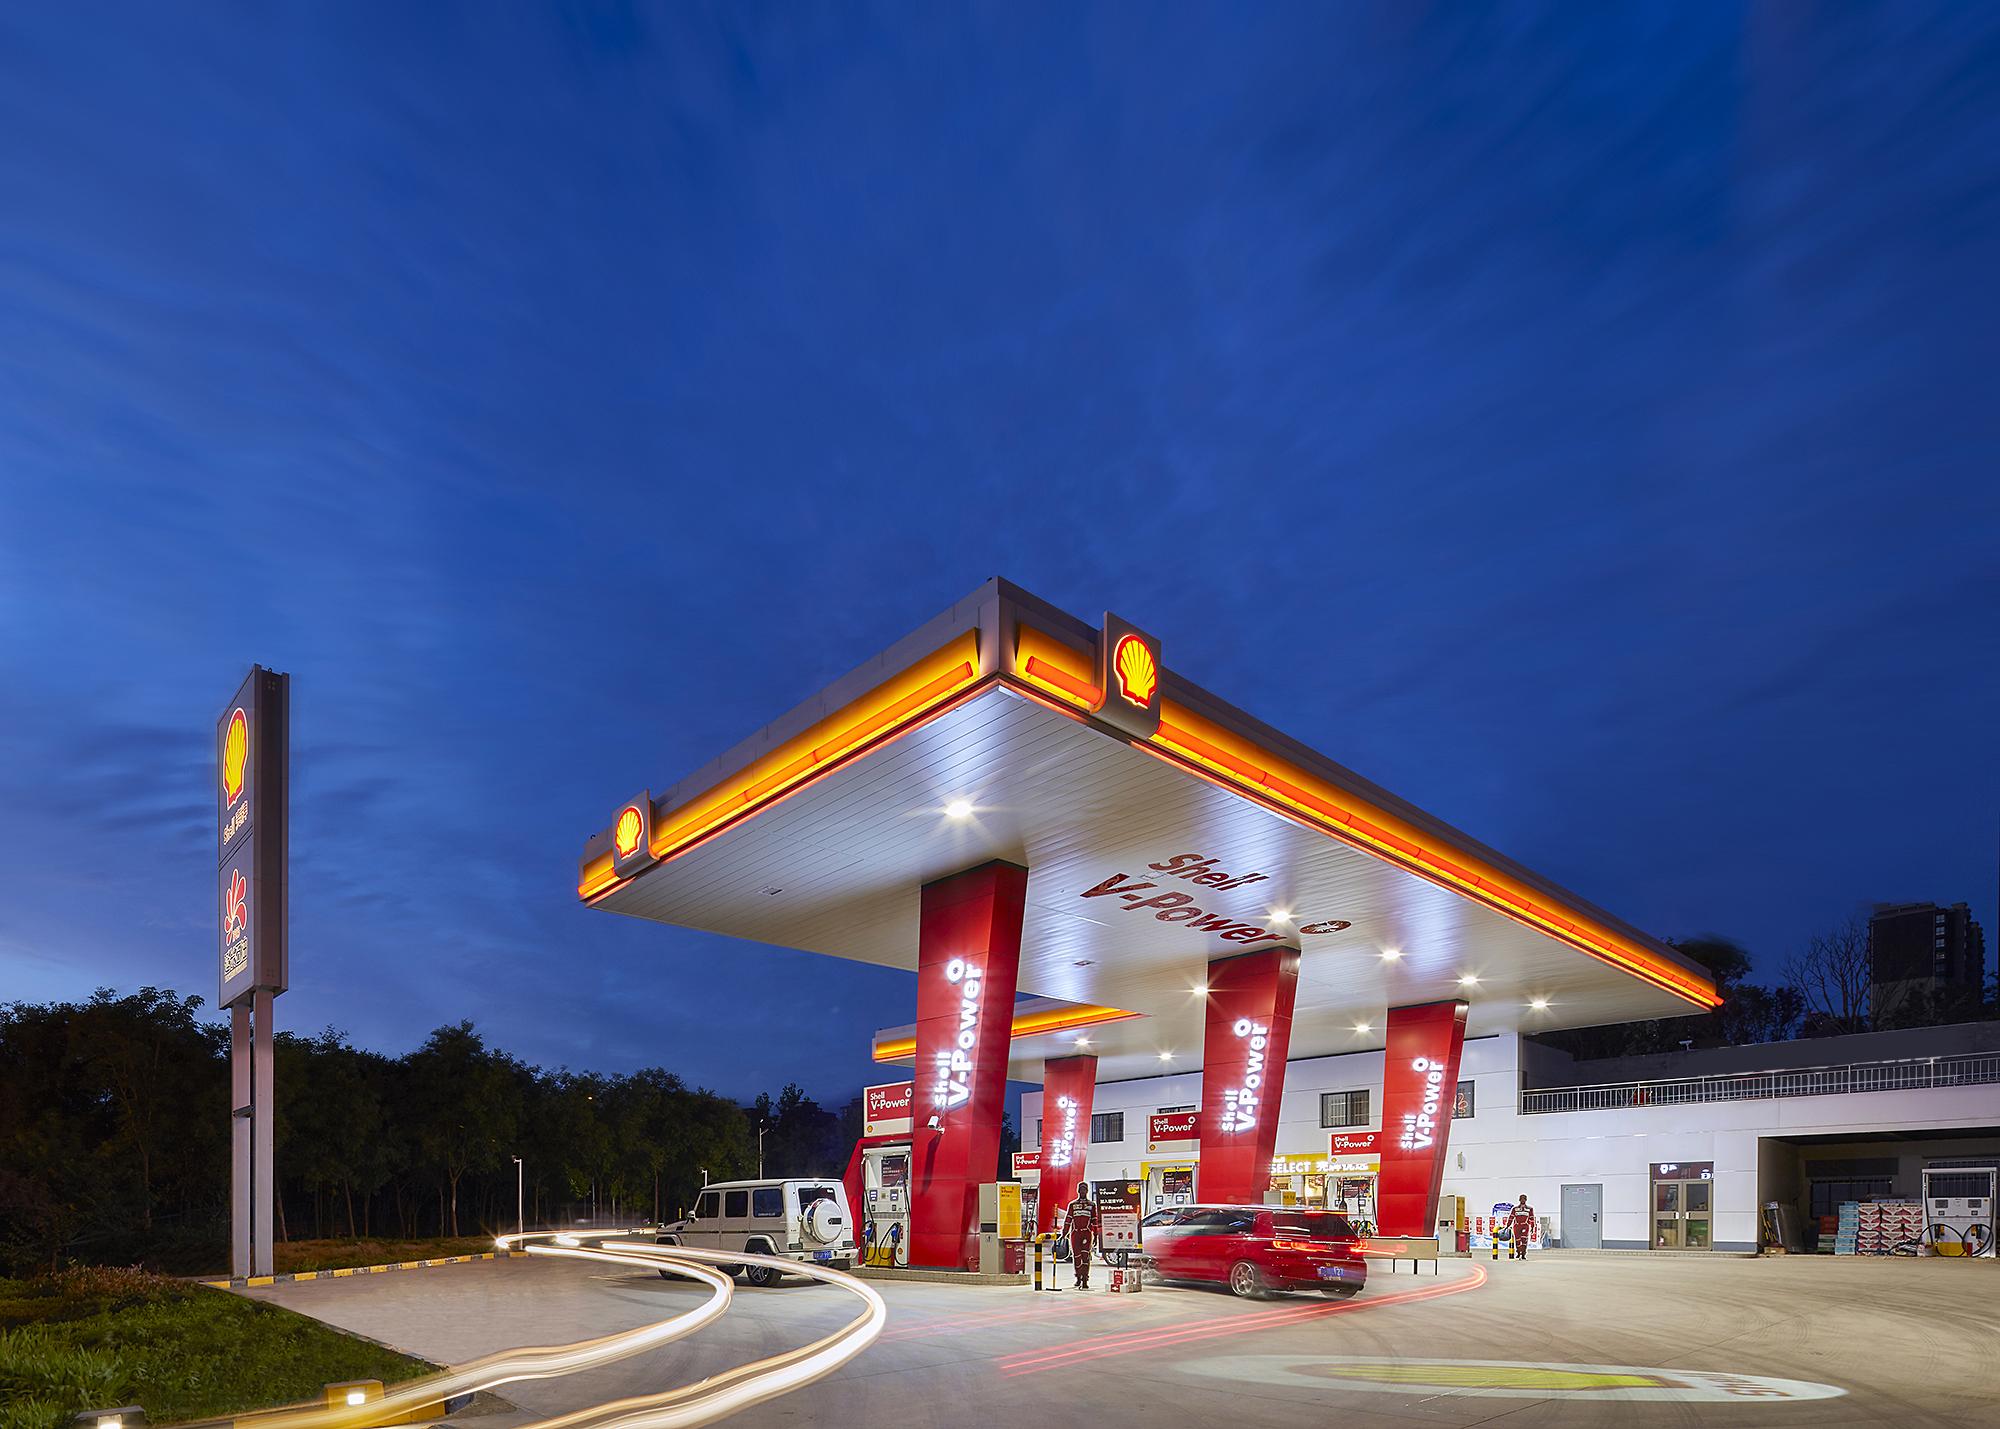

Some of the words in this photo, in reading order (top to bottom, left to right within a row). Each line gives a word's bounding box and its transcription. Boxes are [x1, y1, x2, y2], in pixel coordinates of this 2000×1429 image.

[1148, 853, 1270, 891] Shell
[1080, 872, 1288, 945] V-Power
[947, 963, 983, 1108] V-Power
[934, 1052, 951, 1107] Shell
[1234, 1022, 1268, 1133] V-Power
[869, 1091, 885, 1101] Shell
[870, 1098, 910, 1111] V-Power
[1221, 1089, 1239, 1132] Shell
[1412, 1061, 1444, 1150] V-Power
[1153, 1117, 1169, 1125] Shell
[1153, 1123, 1193, 1133] V-Power
[1400, 1114, 1417, 1149] Shell
[1335, 1141, 1372, 1149] V-Power
[1270, 1161, 1312, 1174] SELECT
